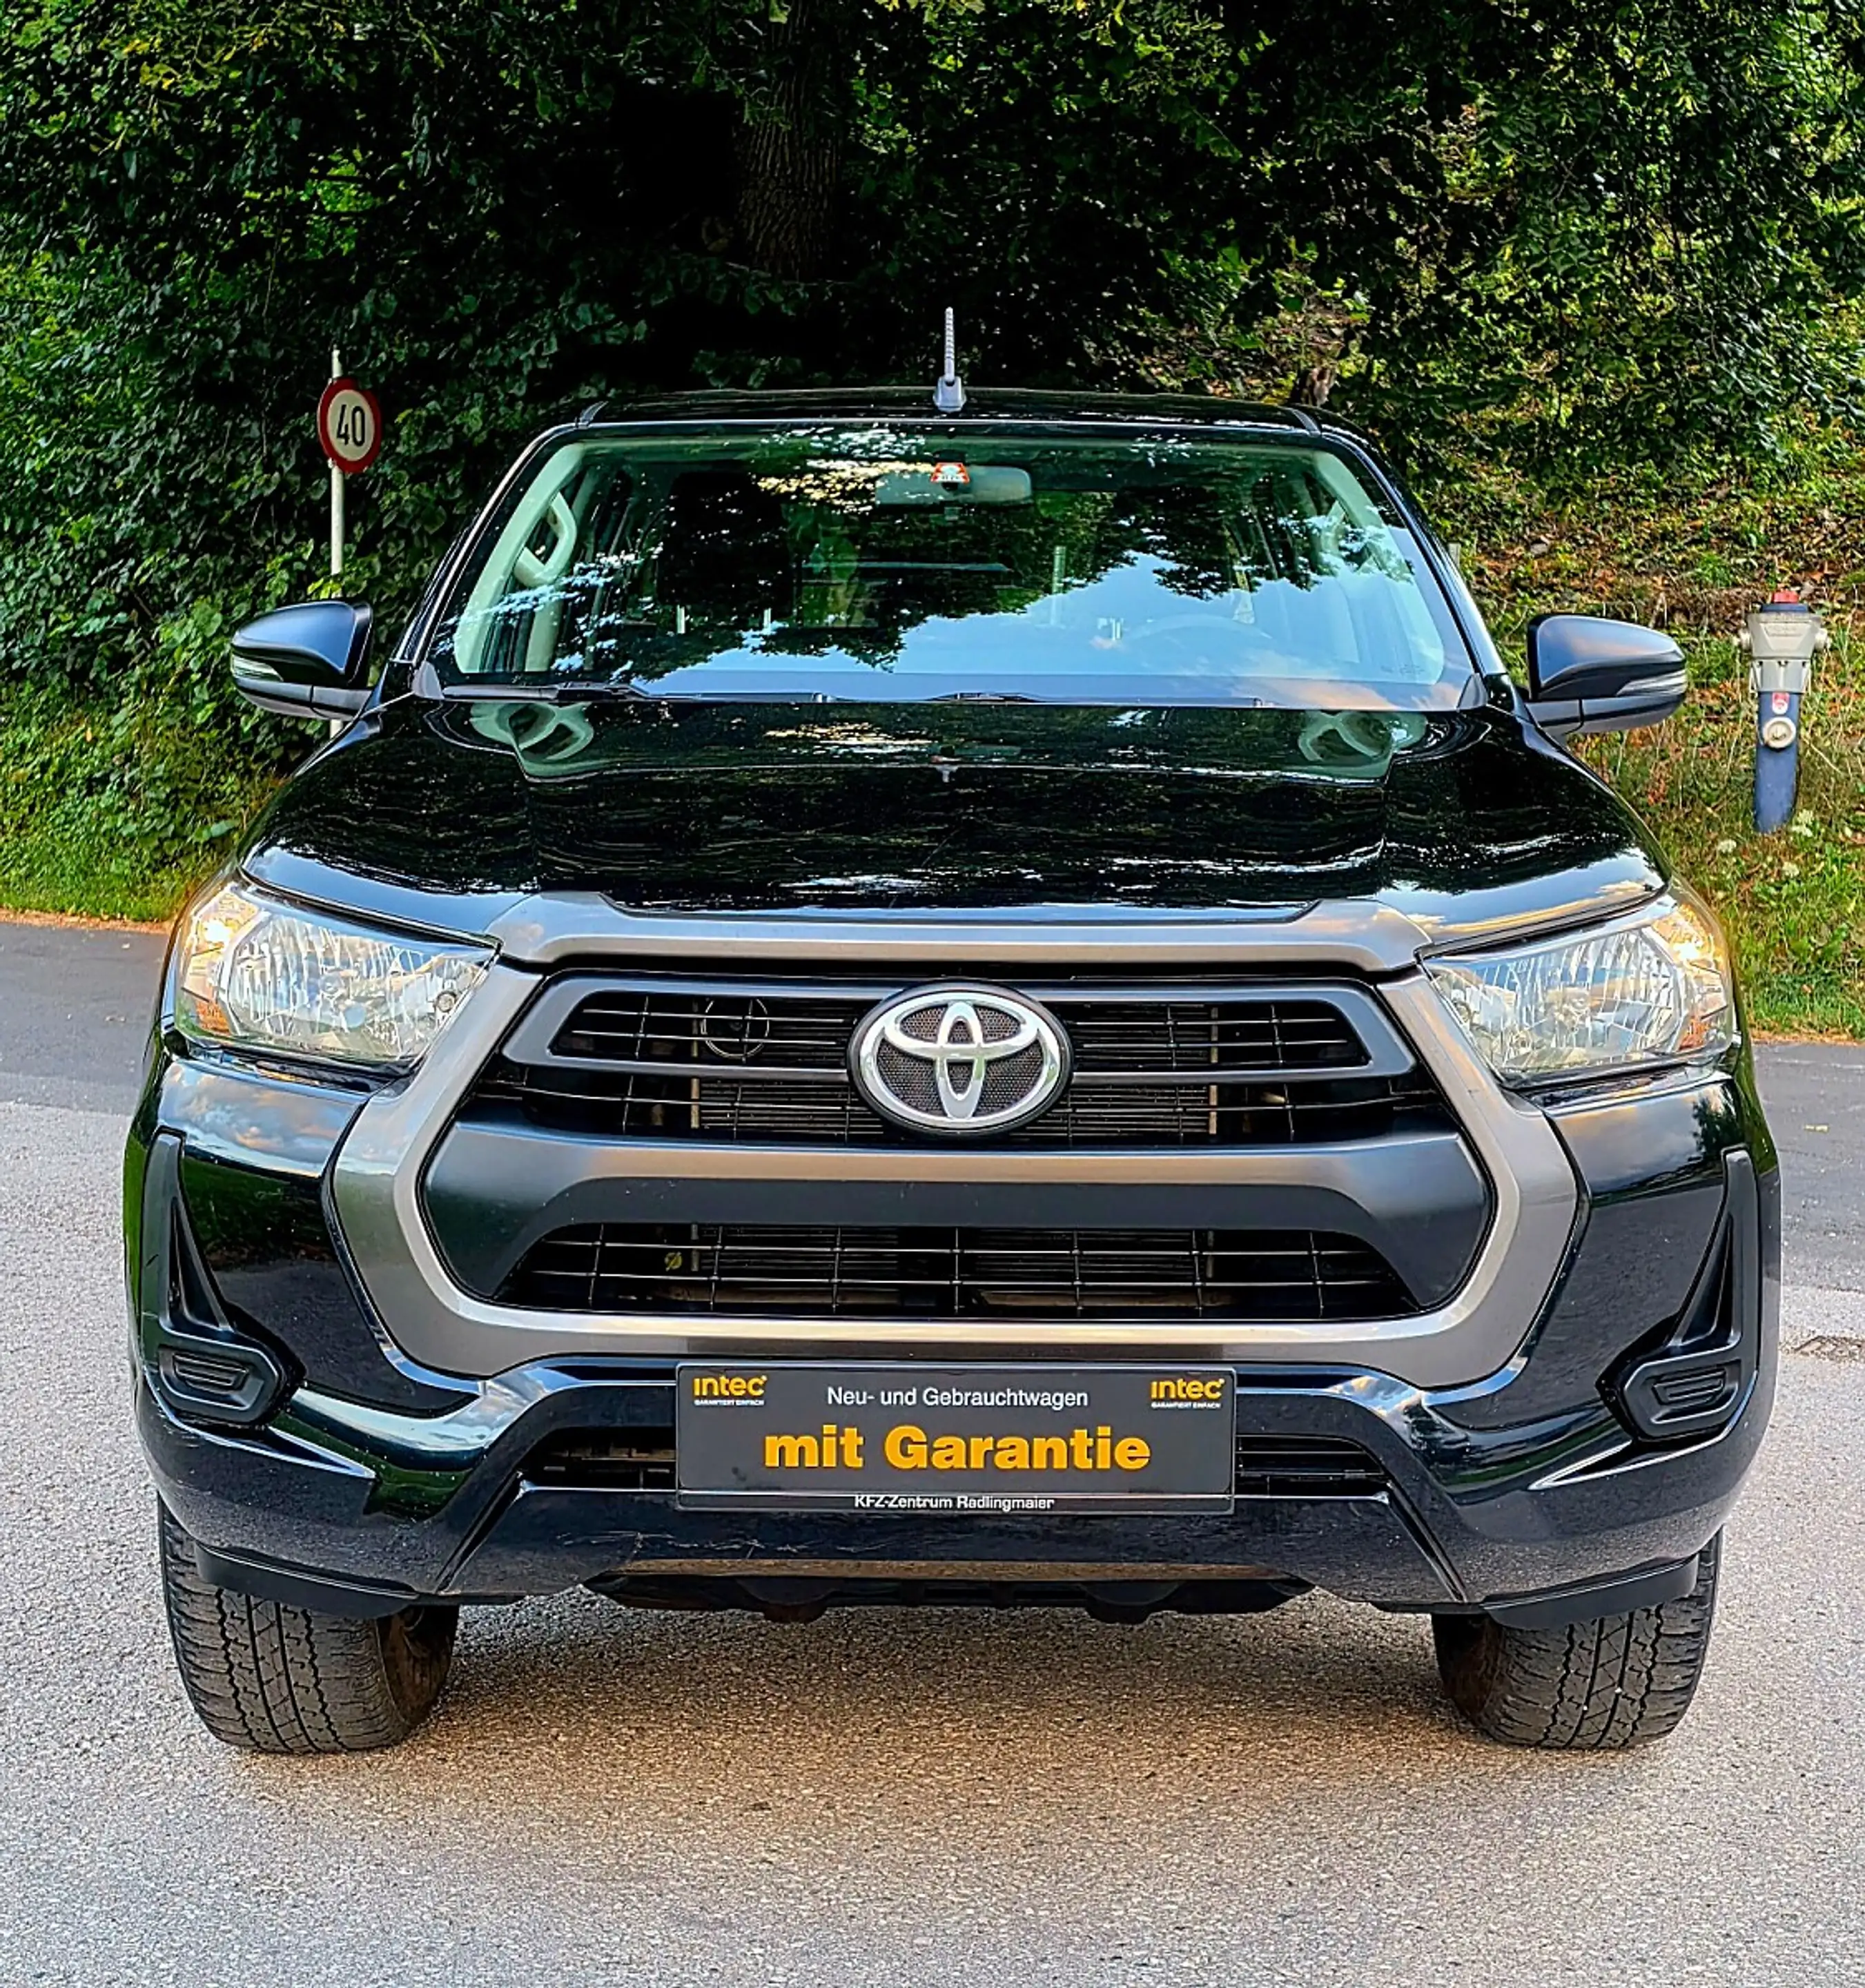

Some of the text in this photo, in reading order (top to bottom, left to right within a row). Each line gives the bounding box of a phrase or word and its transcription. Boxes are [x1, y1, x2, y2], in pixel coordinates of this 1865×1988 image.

[336, 404, 366, 447] 40
[693, 1375, 768, 1396] intec
[1151, 1378, 1225, 1400] intec
[828, 1387, 1088, 1410] Neu- und Gebrauchtwagen
[763, 1424, 1151, 1470] mit Garantie
[855, 1494, 952, 1508] KFZ-Zentrum
